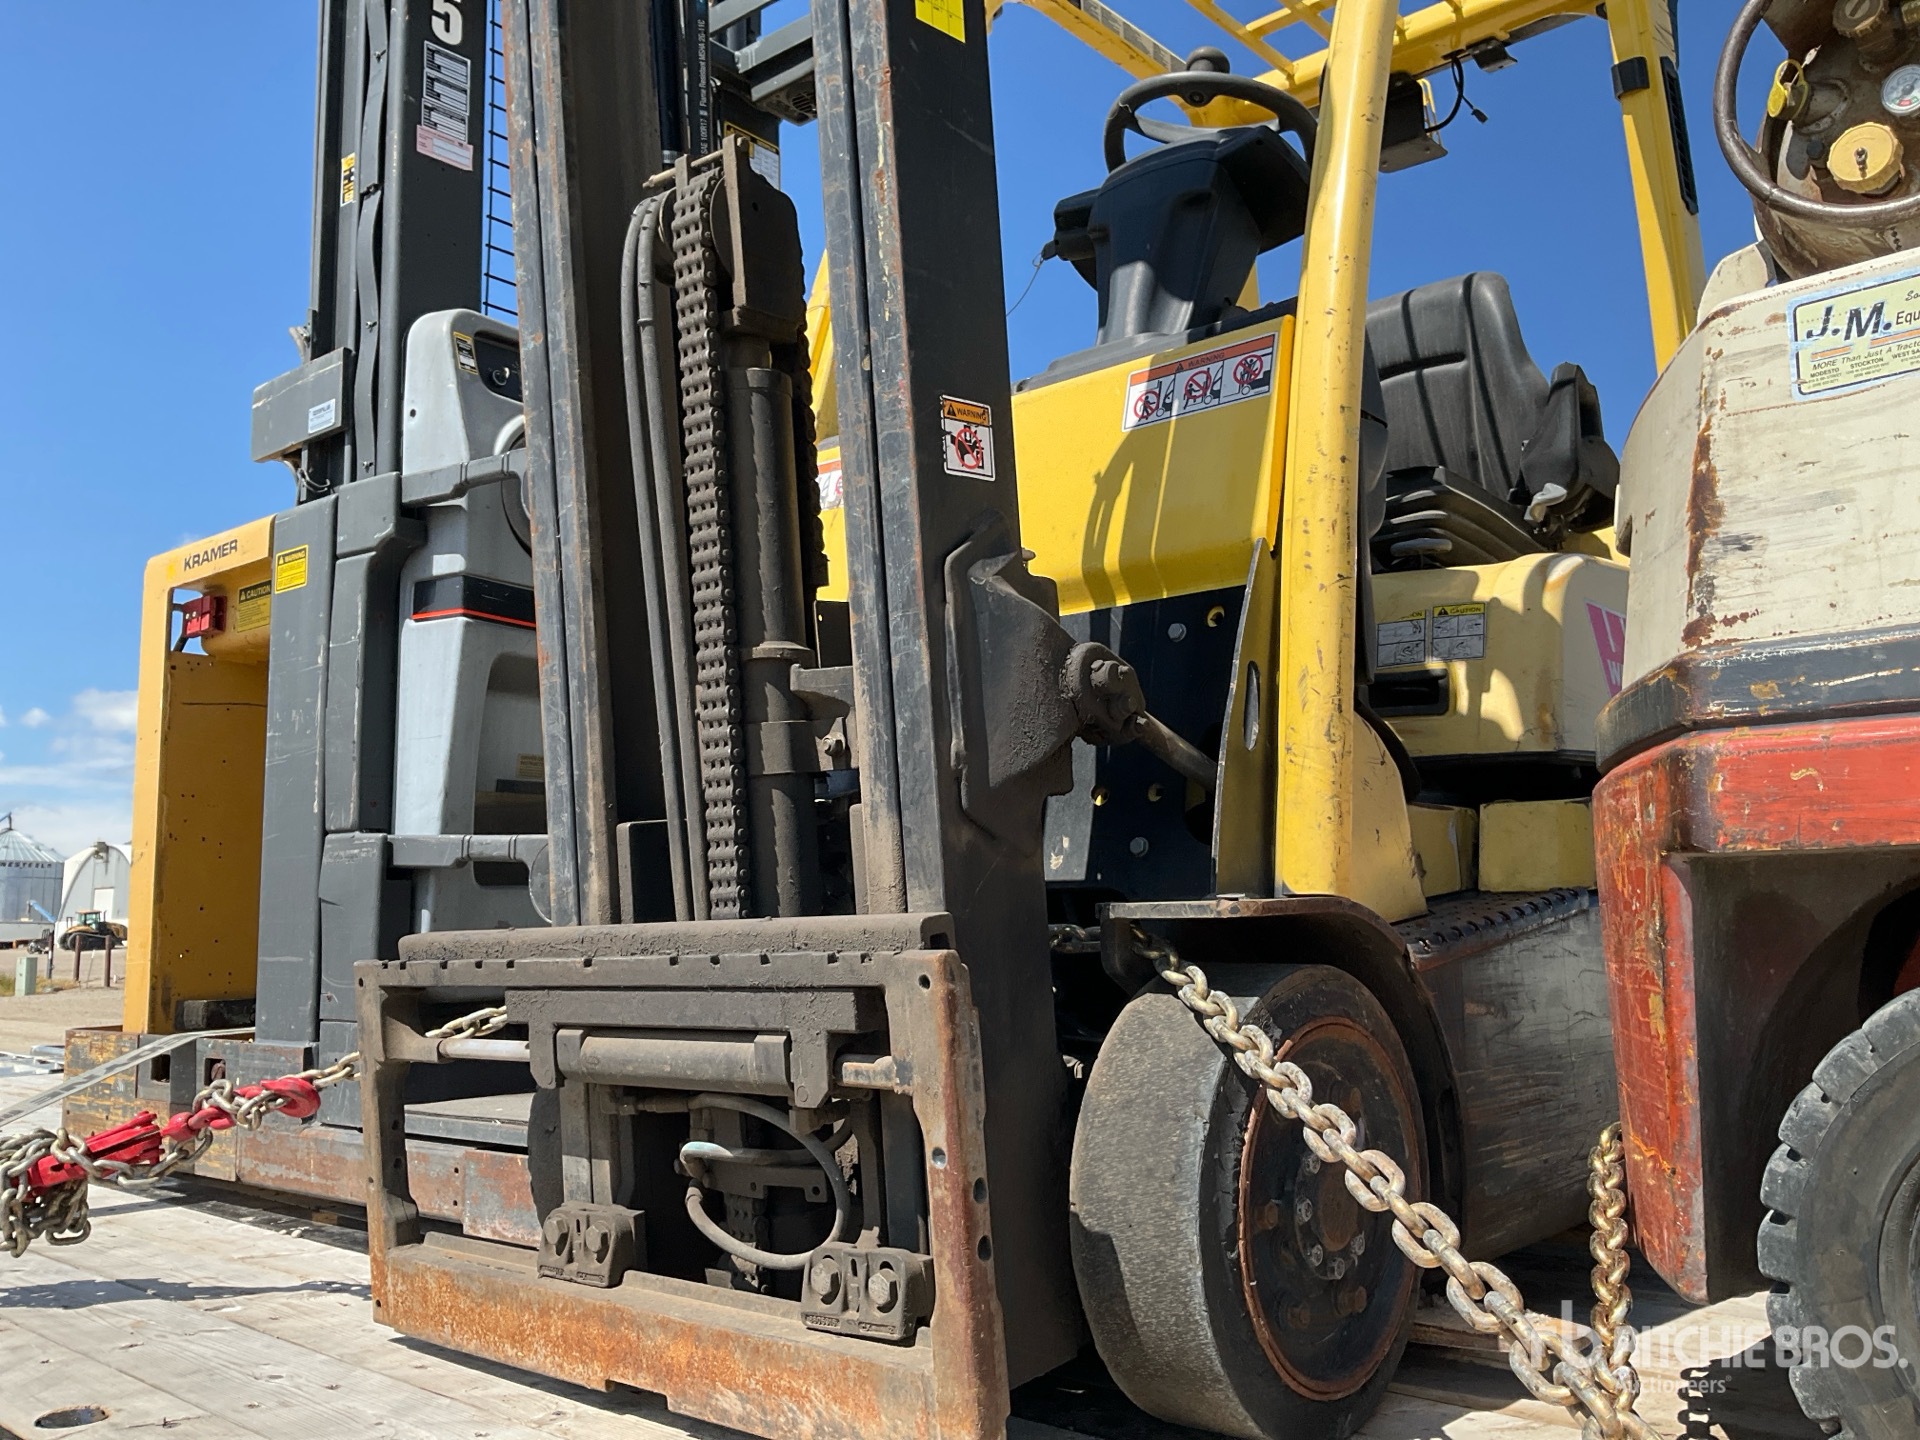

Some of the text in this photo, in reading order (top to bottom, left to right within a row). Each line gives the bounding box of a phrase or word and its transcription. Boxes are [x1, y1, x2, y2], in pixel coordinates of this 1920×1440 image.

[1806, 301, 1892, 341] J.M.
[1188, 352, 1225, 367] WARNING
[1812, 359, 1838, 371] MORE
[1842, 354, 1861, 364] Than
[1864, 349, 1883, 359] Just
[1886, 346, 1892, 354] A
[1891, 350, 1910, 359] WEST
[1850, 357, 1884, 369] STOCKTON
[1810, 367, 1840, 378] MODESTO
[957, 408, 987, 421] WARNING
[184, 539, 238, 572] KRAMER
[246, 585, 271, 599] CAUTION
